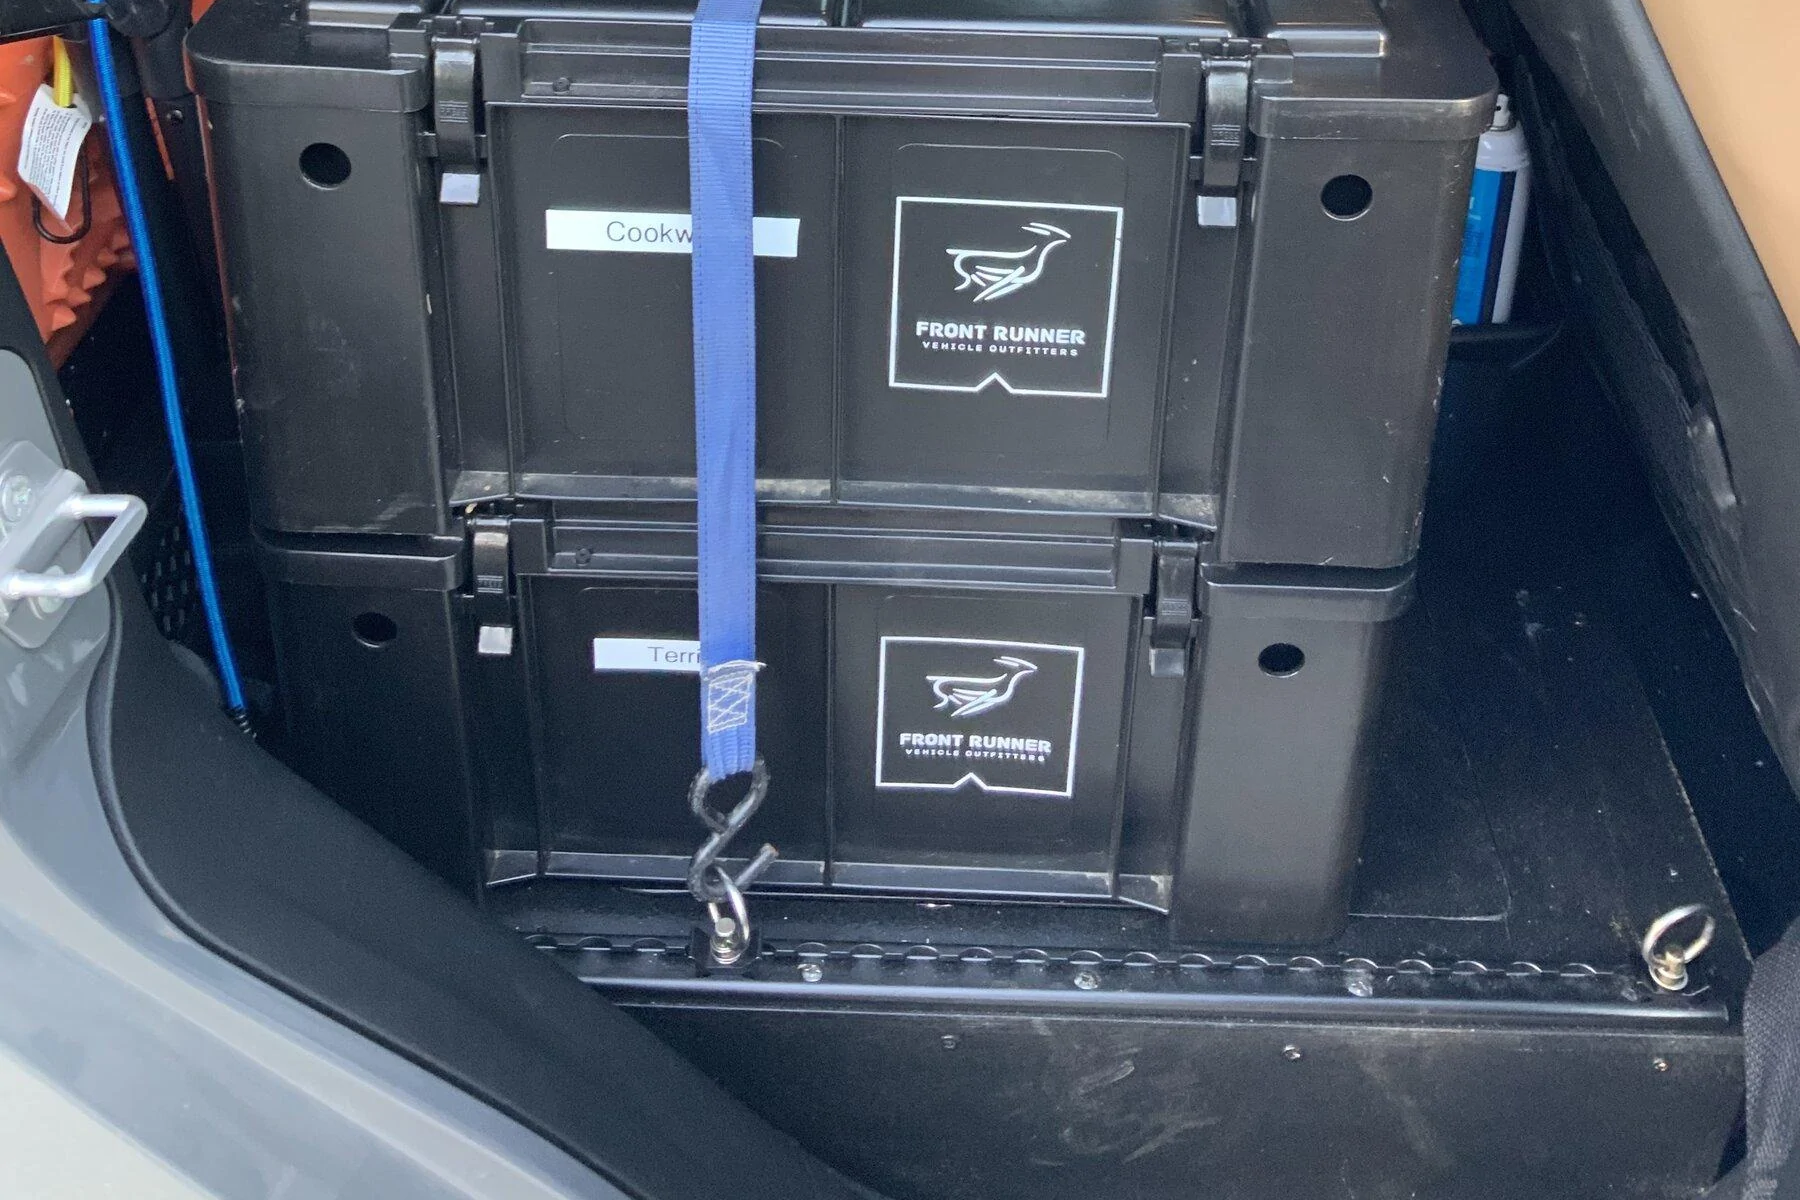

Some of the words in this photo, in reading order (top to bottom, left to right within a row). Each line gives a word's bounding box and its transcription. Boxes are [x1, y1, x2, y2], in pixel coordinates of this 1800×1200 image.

[606, 220, 693, 244] Cookw
[915, 321, 987, 341] FRONT
[993, 325, 1086, 345] RUNNER
[922, 341, 983, 352] VEHICLE
[989, 344, 1079, 357] OUTFITTERS
[899, 732, 965, 747] FRONT
[968, 734, 1053, 753] RUNNER
[905, 748, 960, 757] VEHICLE
[965, 749, 1046, 762] OUTFITTERS
